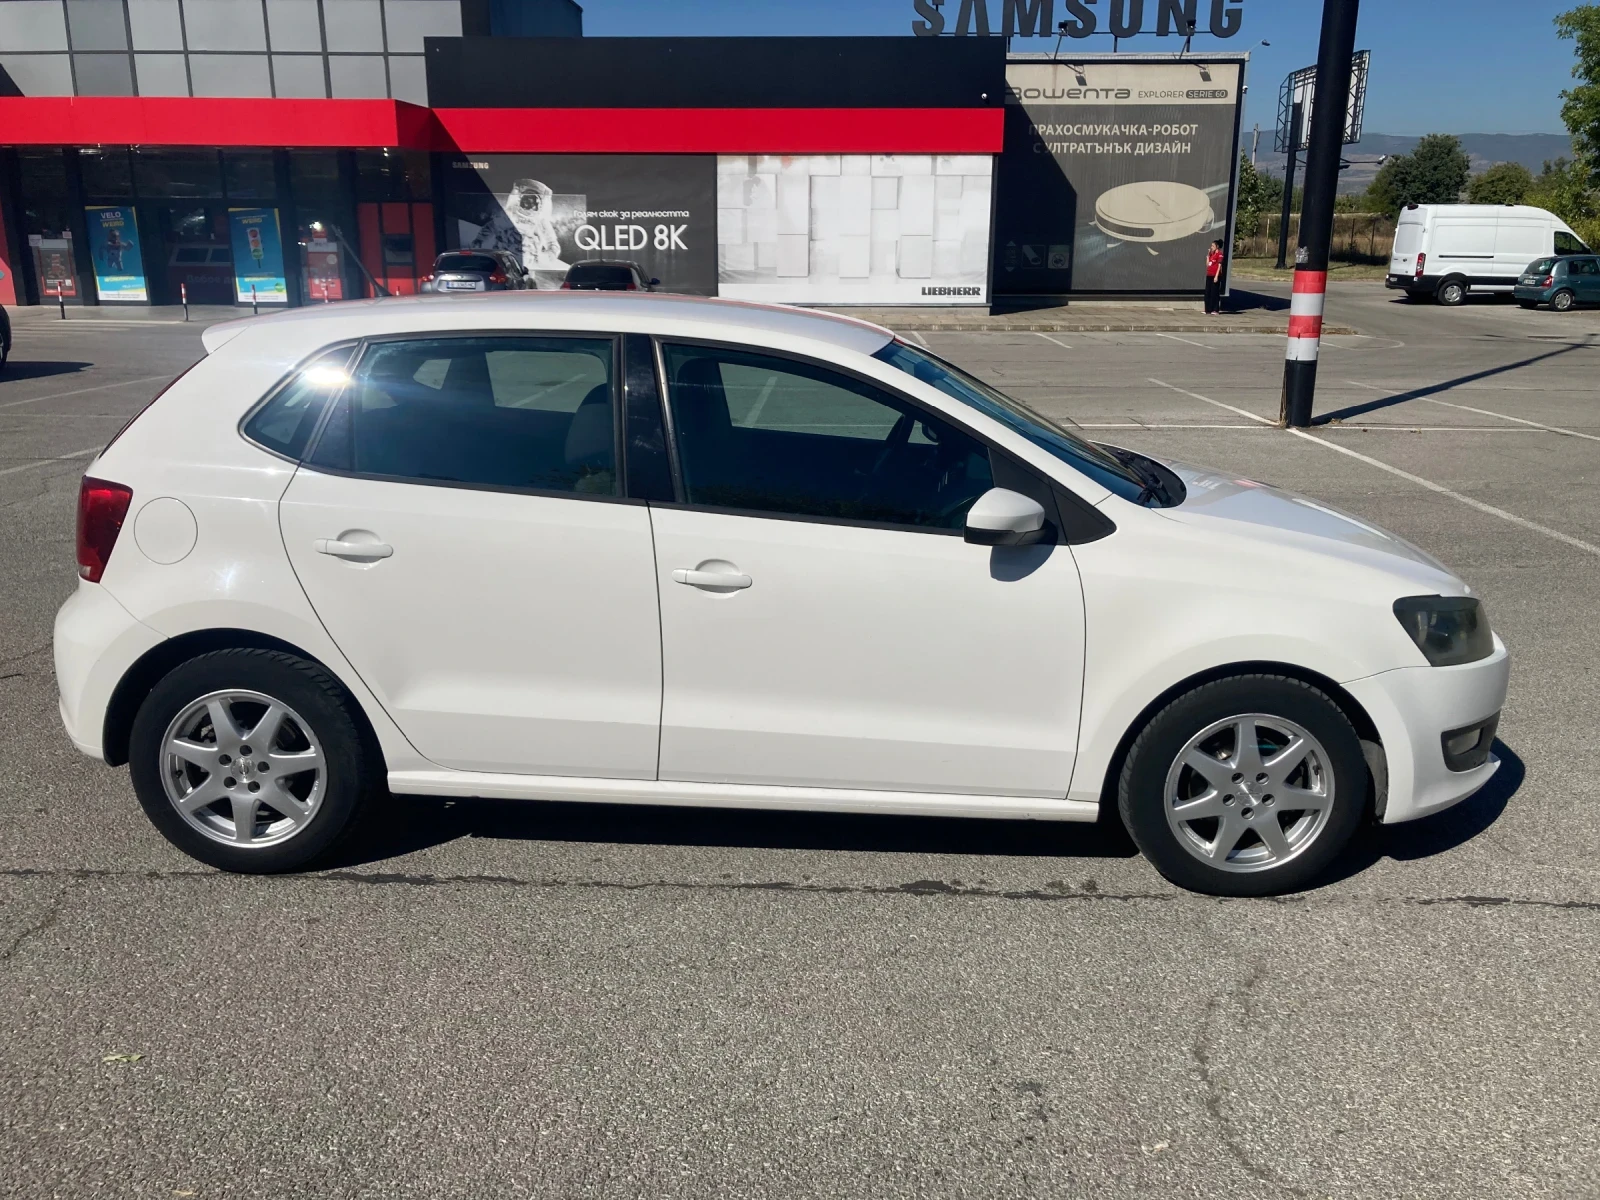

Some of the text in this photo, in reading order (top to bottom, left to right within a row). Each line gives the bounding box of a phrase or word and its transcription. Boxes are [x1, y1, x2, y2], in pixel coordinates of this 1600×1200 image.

[912, 0, 1243, 38] SAMSUNG
[1138, 90, 1226, 99] EXPLORER SERIE 60
[1028, 124, 1198, 136] ПРАХОСМУКАЧКА-РОБОТ
[1033, 140, 1191, 155] С УЛТРАТЪНЪК ДИЗАЙН
[452, 161, 489, 169] SAMSUNG
[100, 211, 121, 219] VELO
[574, 210, 690, 220] Голям скок за реалността
[574, 224, 688, 250] QLED 8K
[921, 286, 981, 296] LIEBHERR
